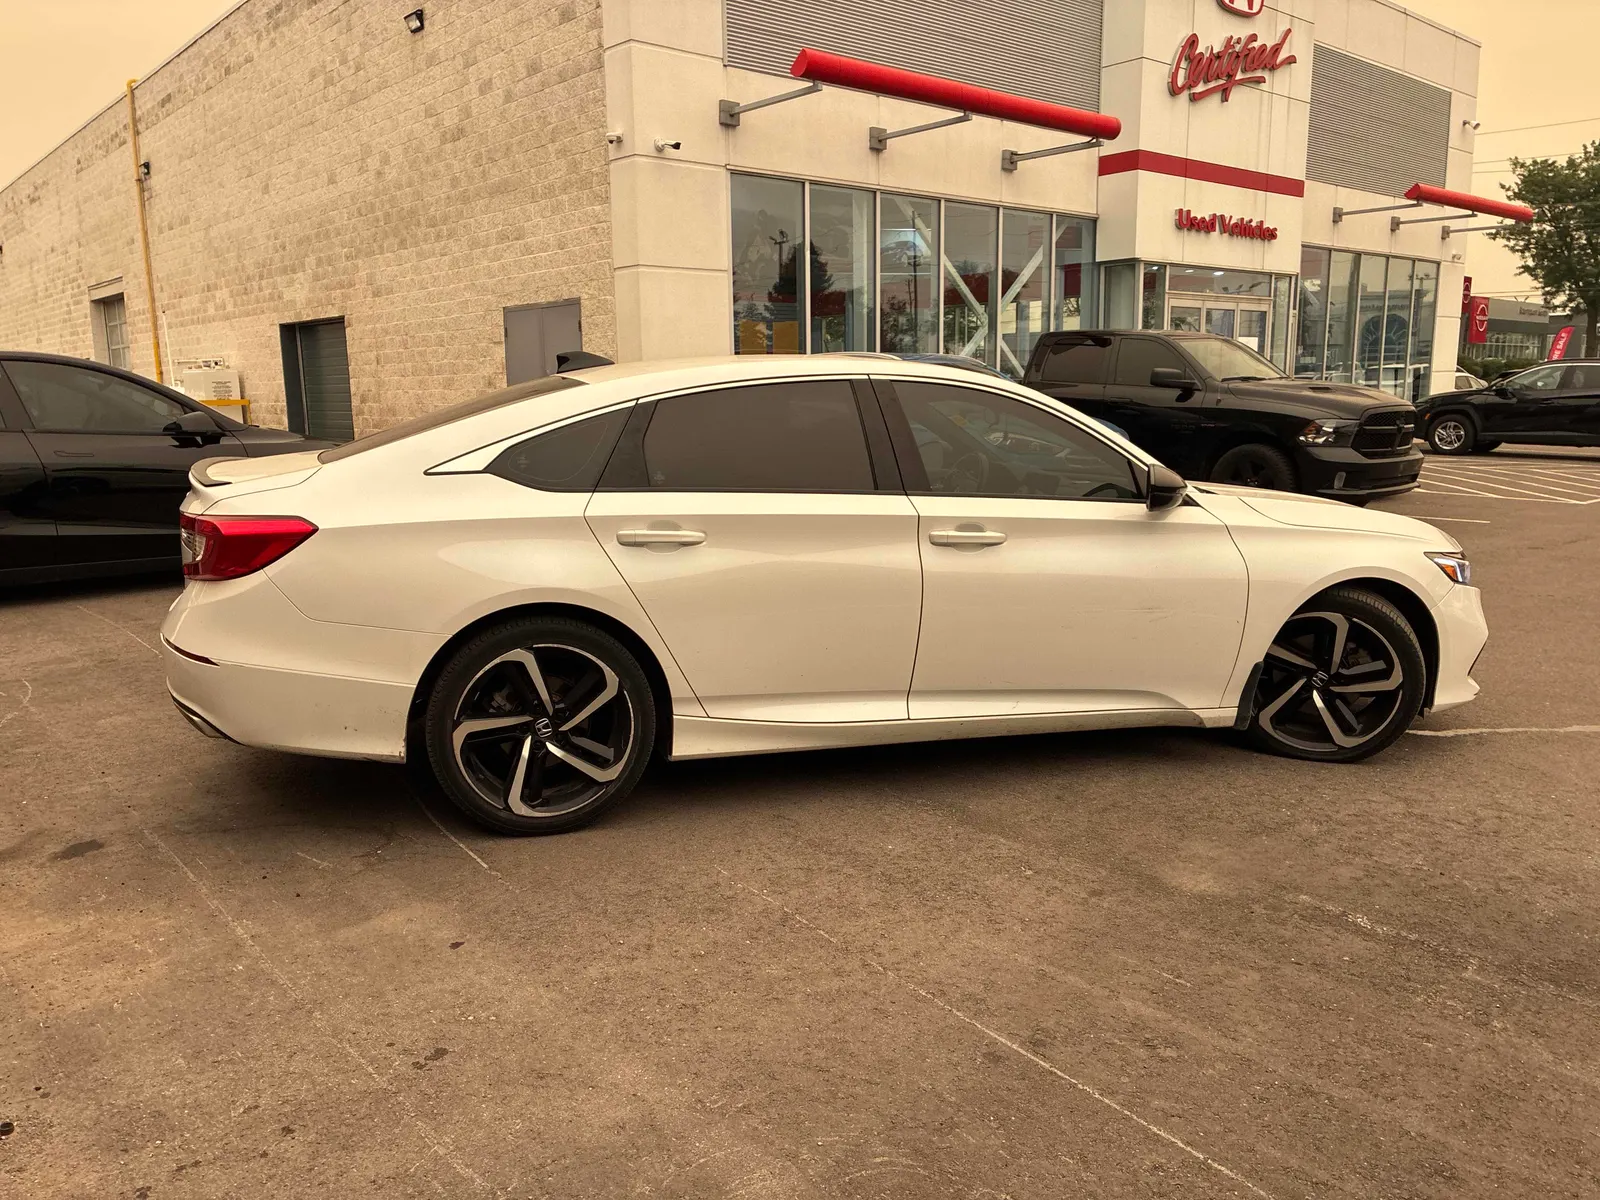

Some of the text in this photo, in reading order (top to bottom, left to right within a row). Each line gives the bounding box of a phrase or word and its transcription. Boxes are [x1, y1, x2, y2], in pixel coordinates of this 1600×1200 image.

[1168, 28, 1296, 102] Certified
[1175, 208, 1278, 241] Used Vehicles
